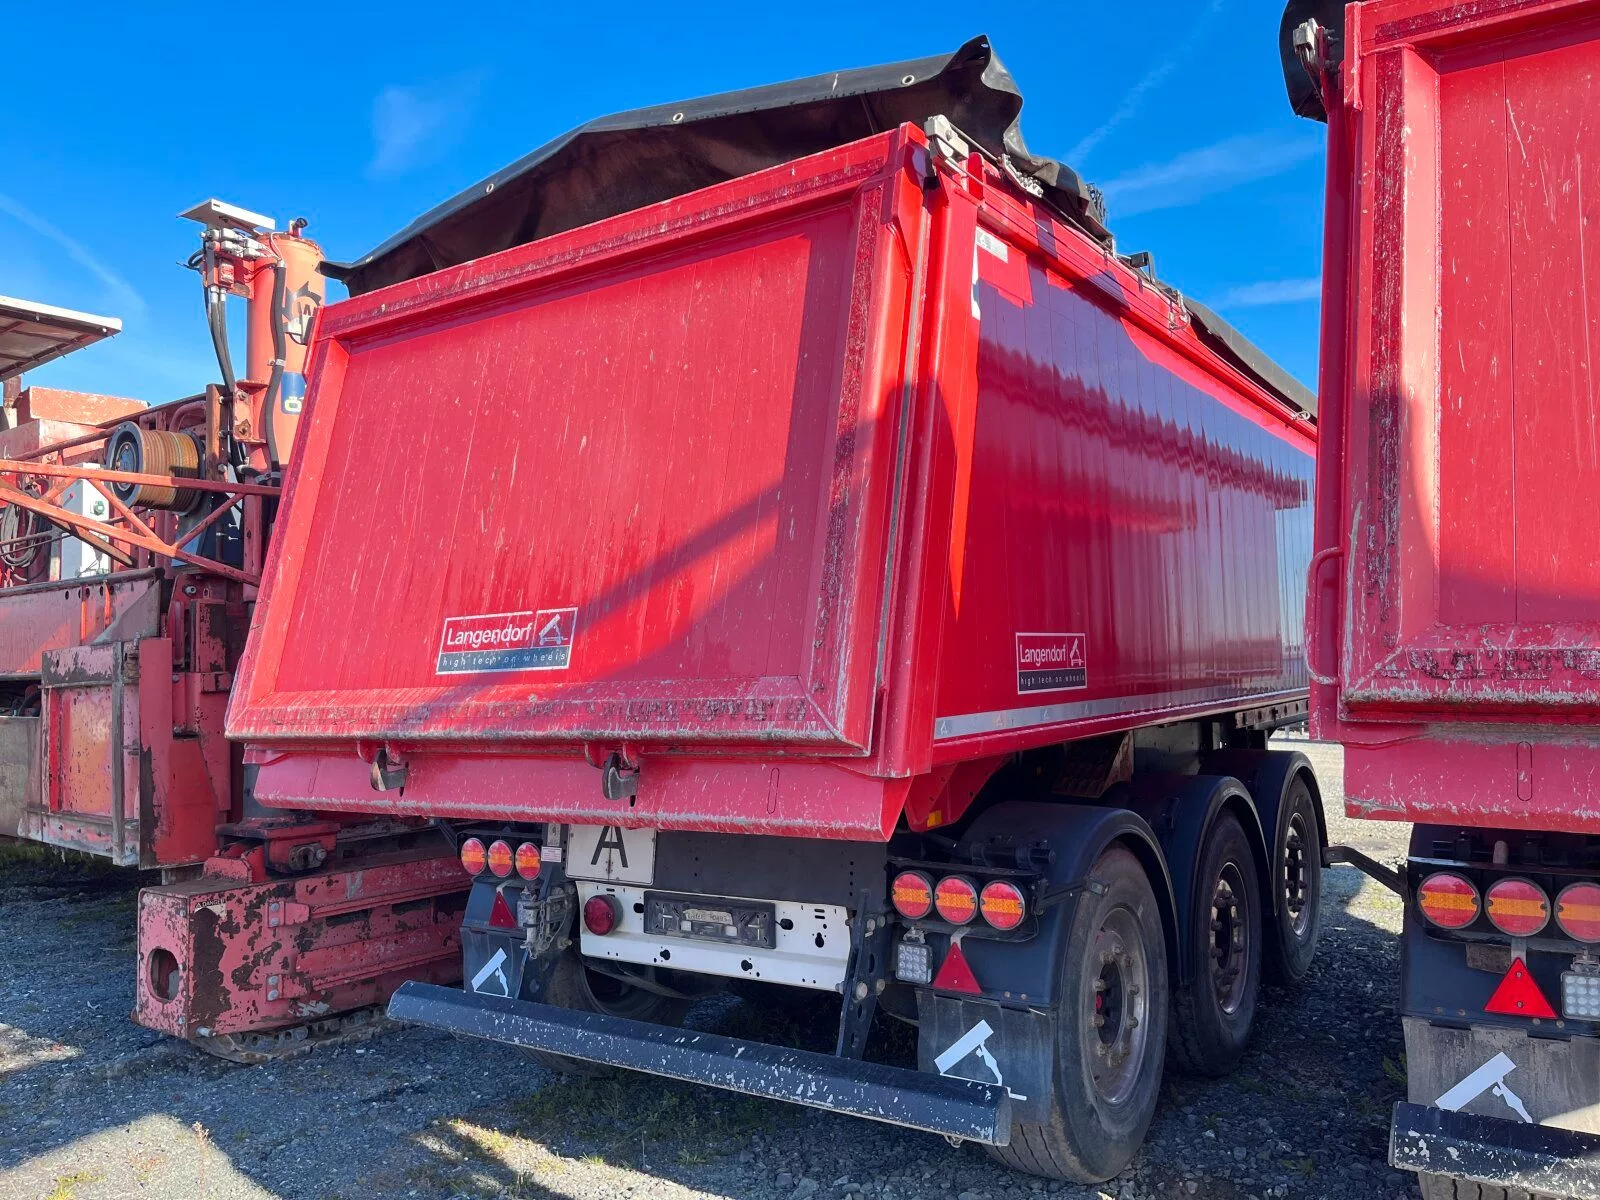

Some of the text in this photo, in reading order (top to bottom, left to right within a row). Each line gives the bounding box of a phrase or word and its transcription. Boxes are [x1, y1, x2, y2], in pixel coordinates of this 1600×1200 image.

[447, 622, 533, 648] Langendorf
[442, 657, 466, 668] high
[473, 656, 497, 666] tech
[1020, 644, 1066, 667] Langendorf
[1020, 676, 1035, 687] high
[591, 826, 628, 868] A
